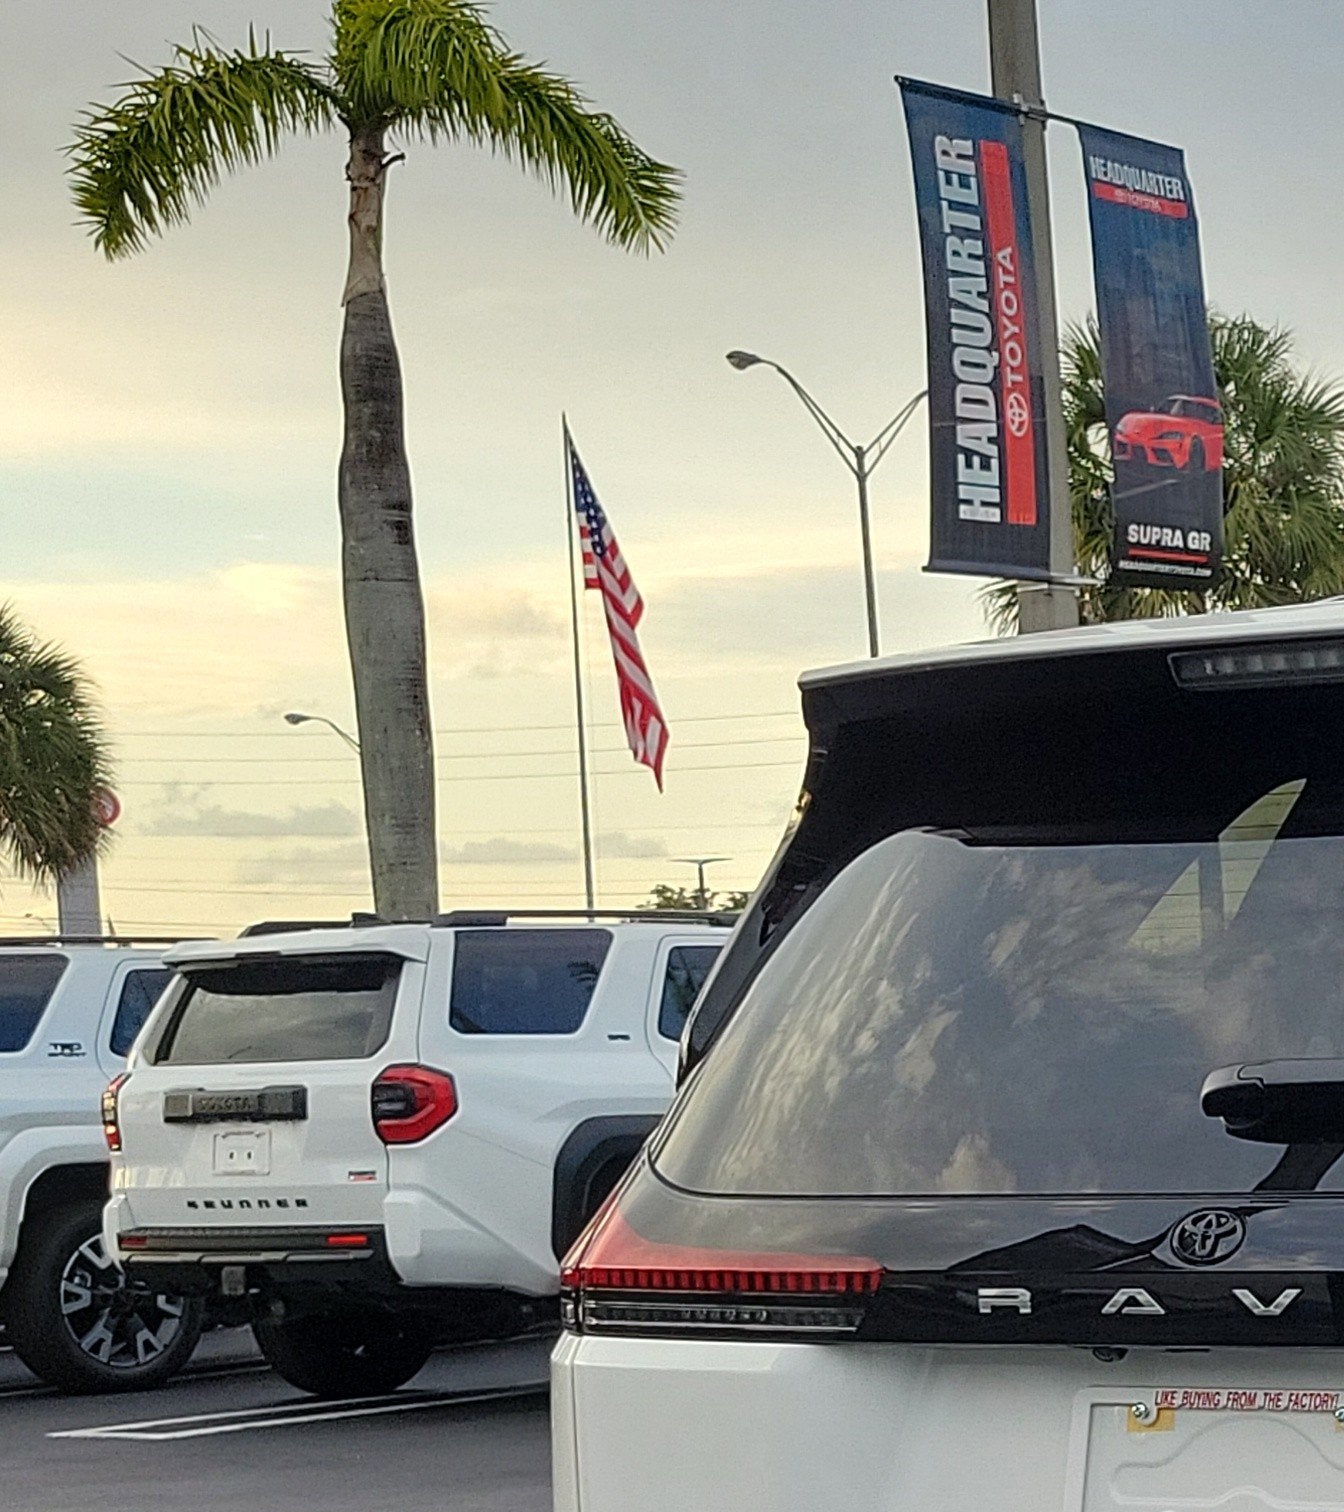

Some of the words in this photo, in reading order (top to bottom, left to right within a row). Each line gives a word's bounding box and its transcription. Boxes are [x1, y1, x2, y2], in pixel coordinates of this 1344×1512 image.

[935, 134, 1002, 523] HEADQUARTER
[997, 247, 1025, 388] TOYOTA
[1127, 523, 1184, 548] SUPRA
[1187, 530, 1211, 552] GR
[1154, 1390, 1177, 1406] LIKE
[1182, 1390, 1221, 1407] BUYING
[1225, 1391, 1258, 1407] FROM
[1263, 1392, 1283, 1408] THE
[1288, 1392, 1340, 1410] FACTORY!
